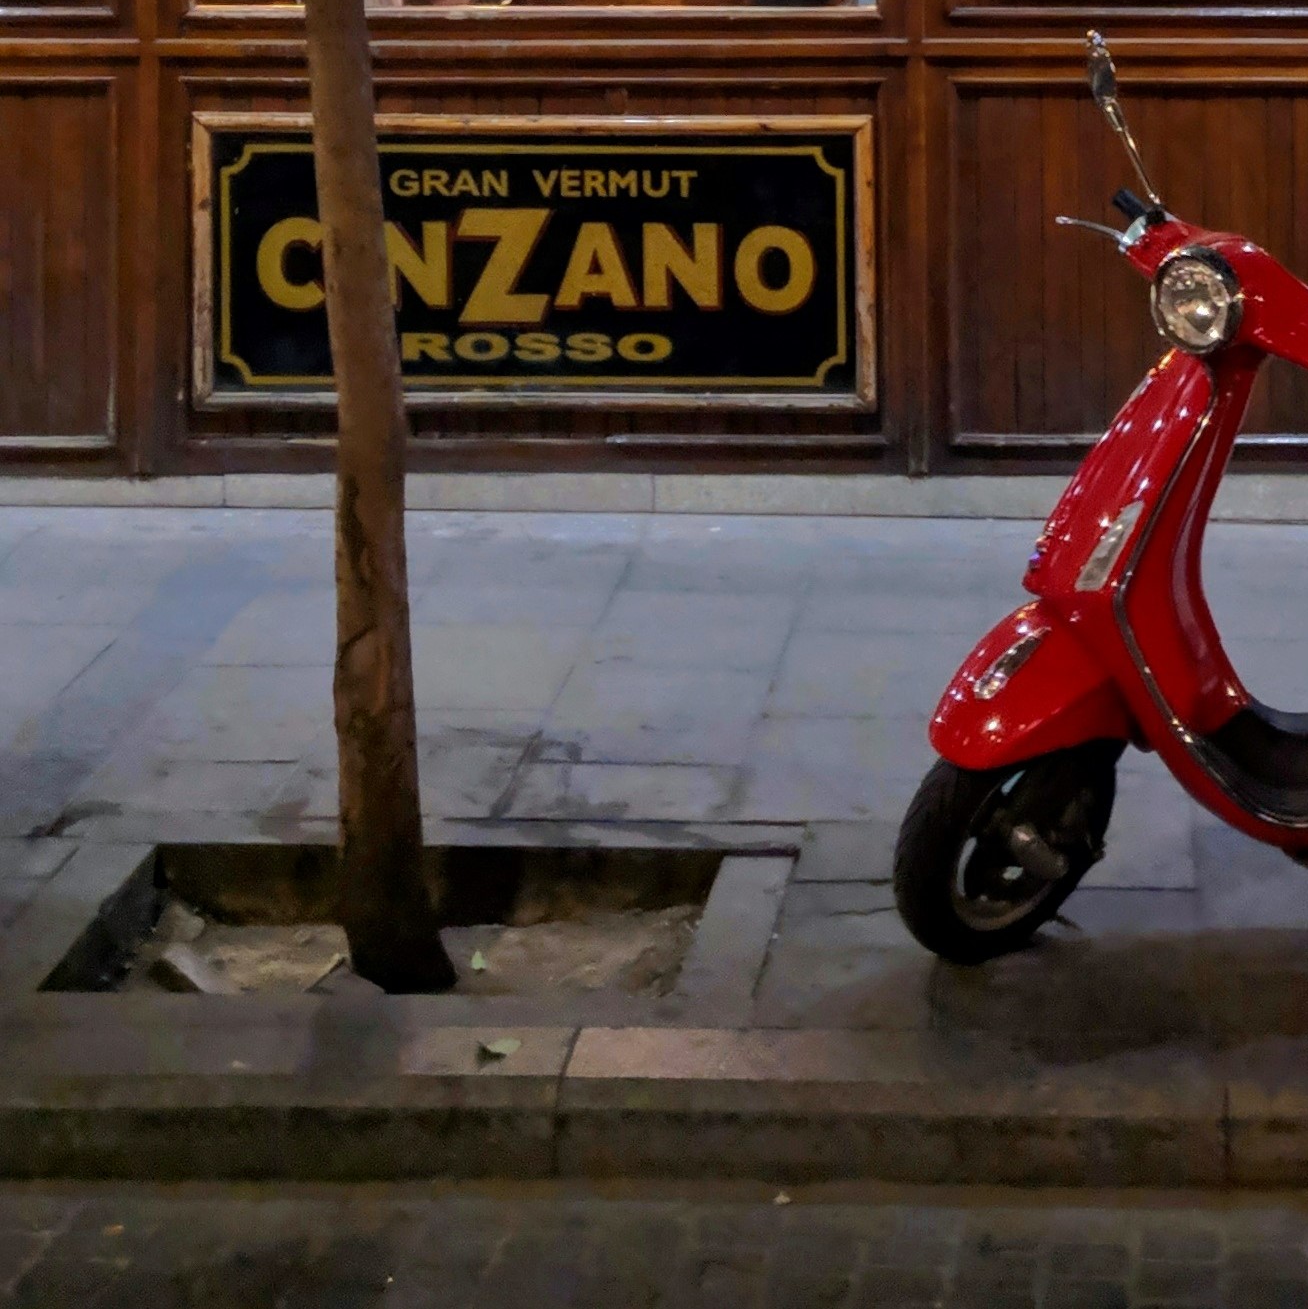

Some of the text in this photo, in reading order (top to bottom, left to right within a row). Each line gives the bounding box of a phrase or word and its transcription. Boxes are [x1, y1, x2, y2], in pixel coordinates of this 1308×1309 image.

[388, 168, 698, 198] GRAN VERMUT
[256, 207, 818, 331] CNZANO
[401, 332, 674, 364] ROSSO
